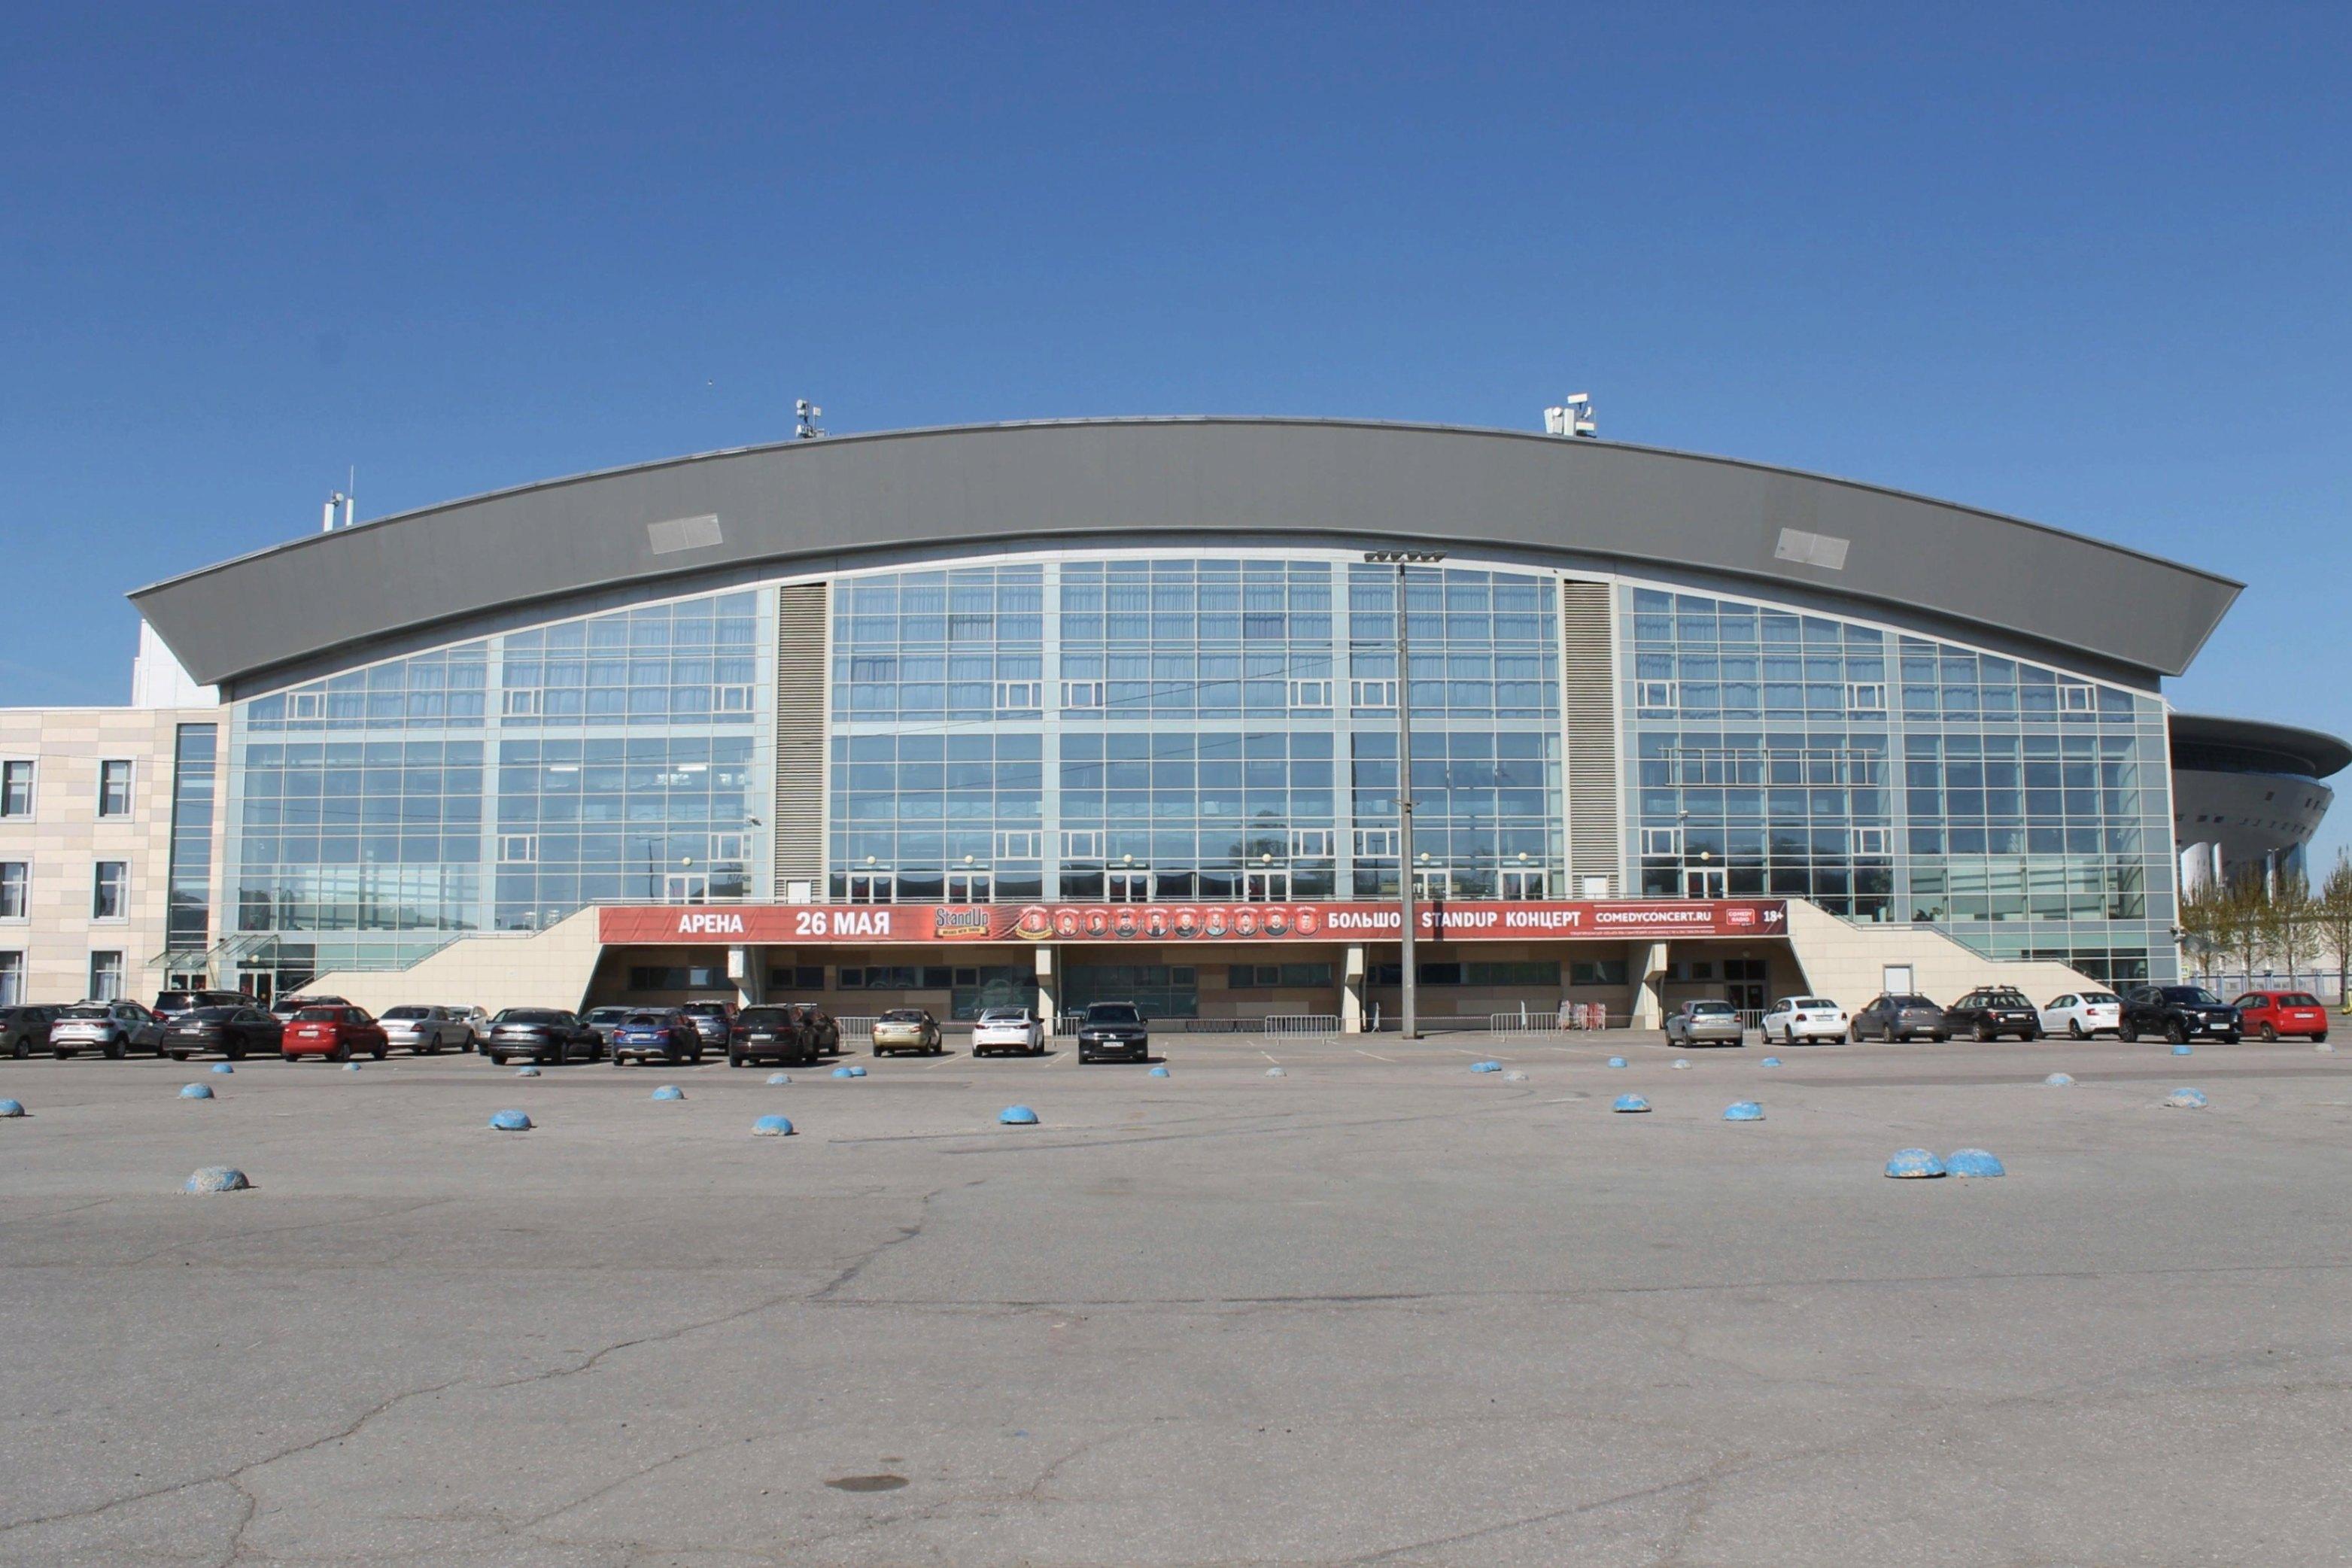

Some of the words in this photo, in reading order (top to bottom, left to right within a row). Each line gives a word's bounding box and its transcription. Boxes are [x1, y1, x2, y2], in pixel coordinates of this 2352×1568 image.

[679, 914, 743, 933] АРЕНА
[795, 912, 826, 935] 26
[834, 911, 890, 935] МАЯ
[936, 907, 989, 926] StandUp
[1328, 912, 1401, 928] БОЛЬШО
[1421, 912, 1498, 928] STANDUP
[1506, 911, 1582, 929] КОНЦЕРТ
[1596, 911, 1712, 922] COMEDYCONCERT.RU
[1764, 910, 1784, 922] 18+
